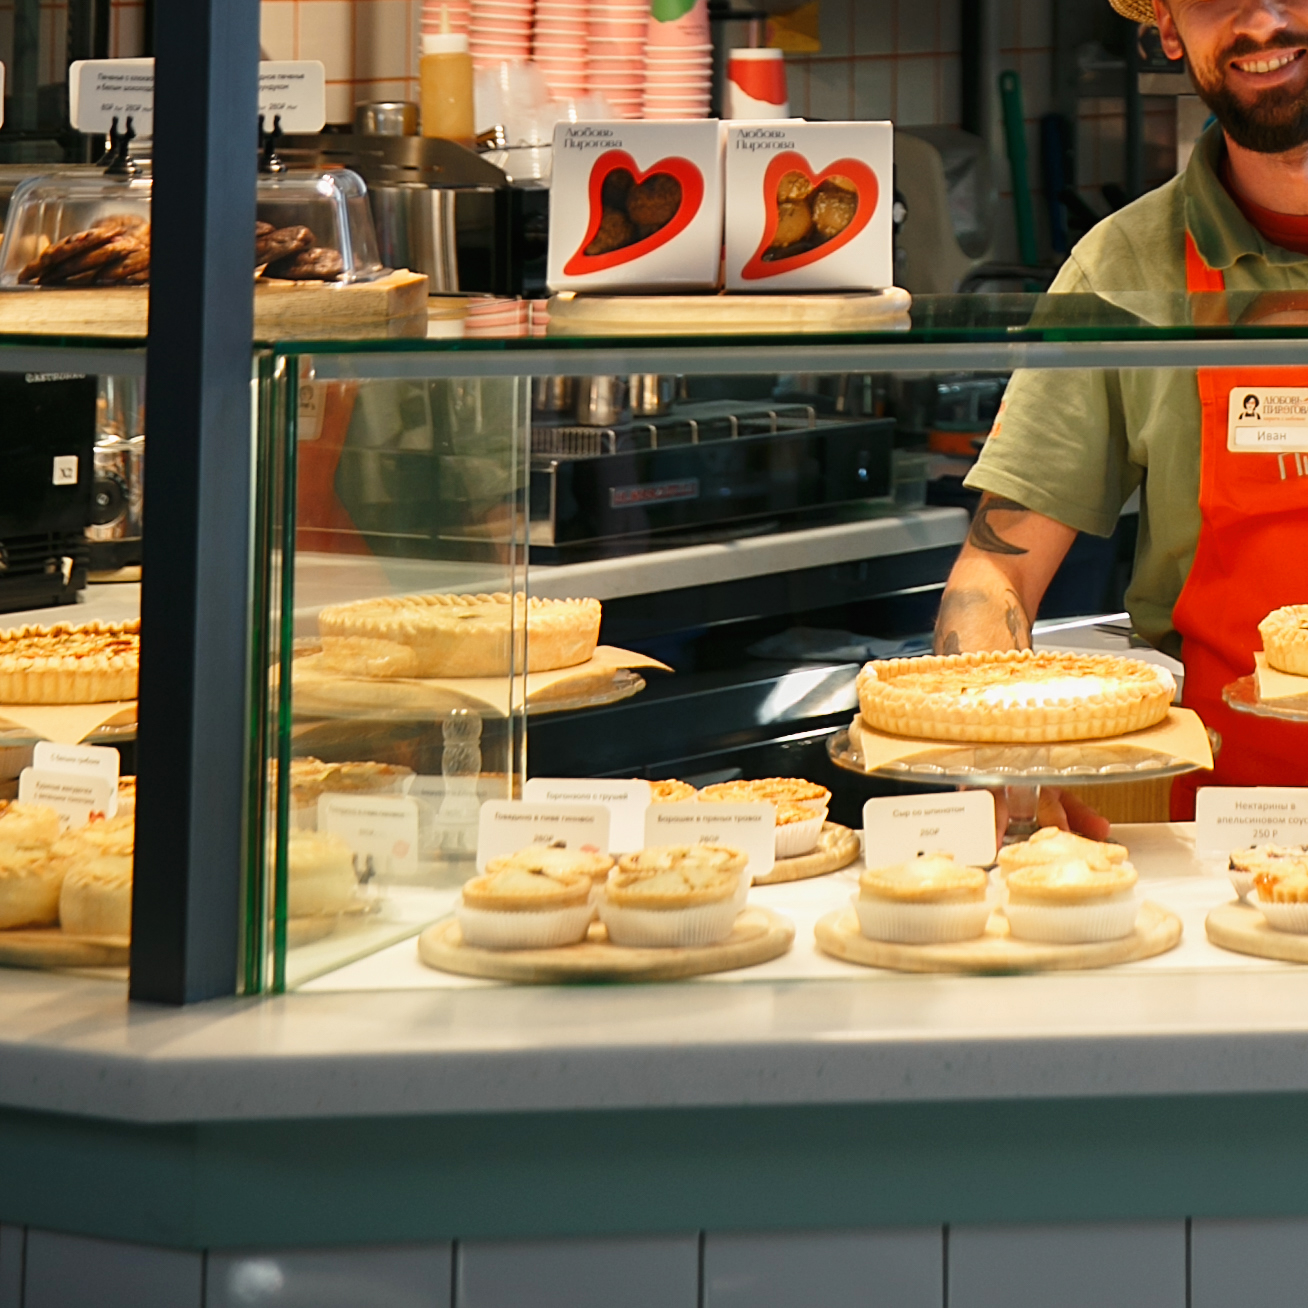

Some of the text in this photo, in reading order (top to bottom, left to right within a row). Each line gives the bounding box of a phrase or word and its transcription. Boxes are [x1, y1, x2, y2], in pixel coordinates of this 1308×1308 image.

[565, 127, 614, 138] Любовь
[737, 128, 786, 139] Любовь
[564, 137, 623, 151] Пирогова
[736, 139, 795, 152] Пирогова
[1257, 431, 1287, 441] Иван
[1235, 800, 1288, 812] Нектарины
[1217, 815, 1285, 825] апельсиновом
[1253, 829, 1270, 838] 250
